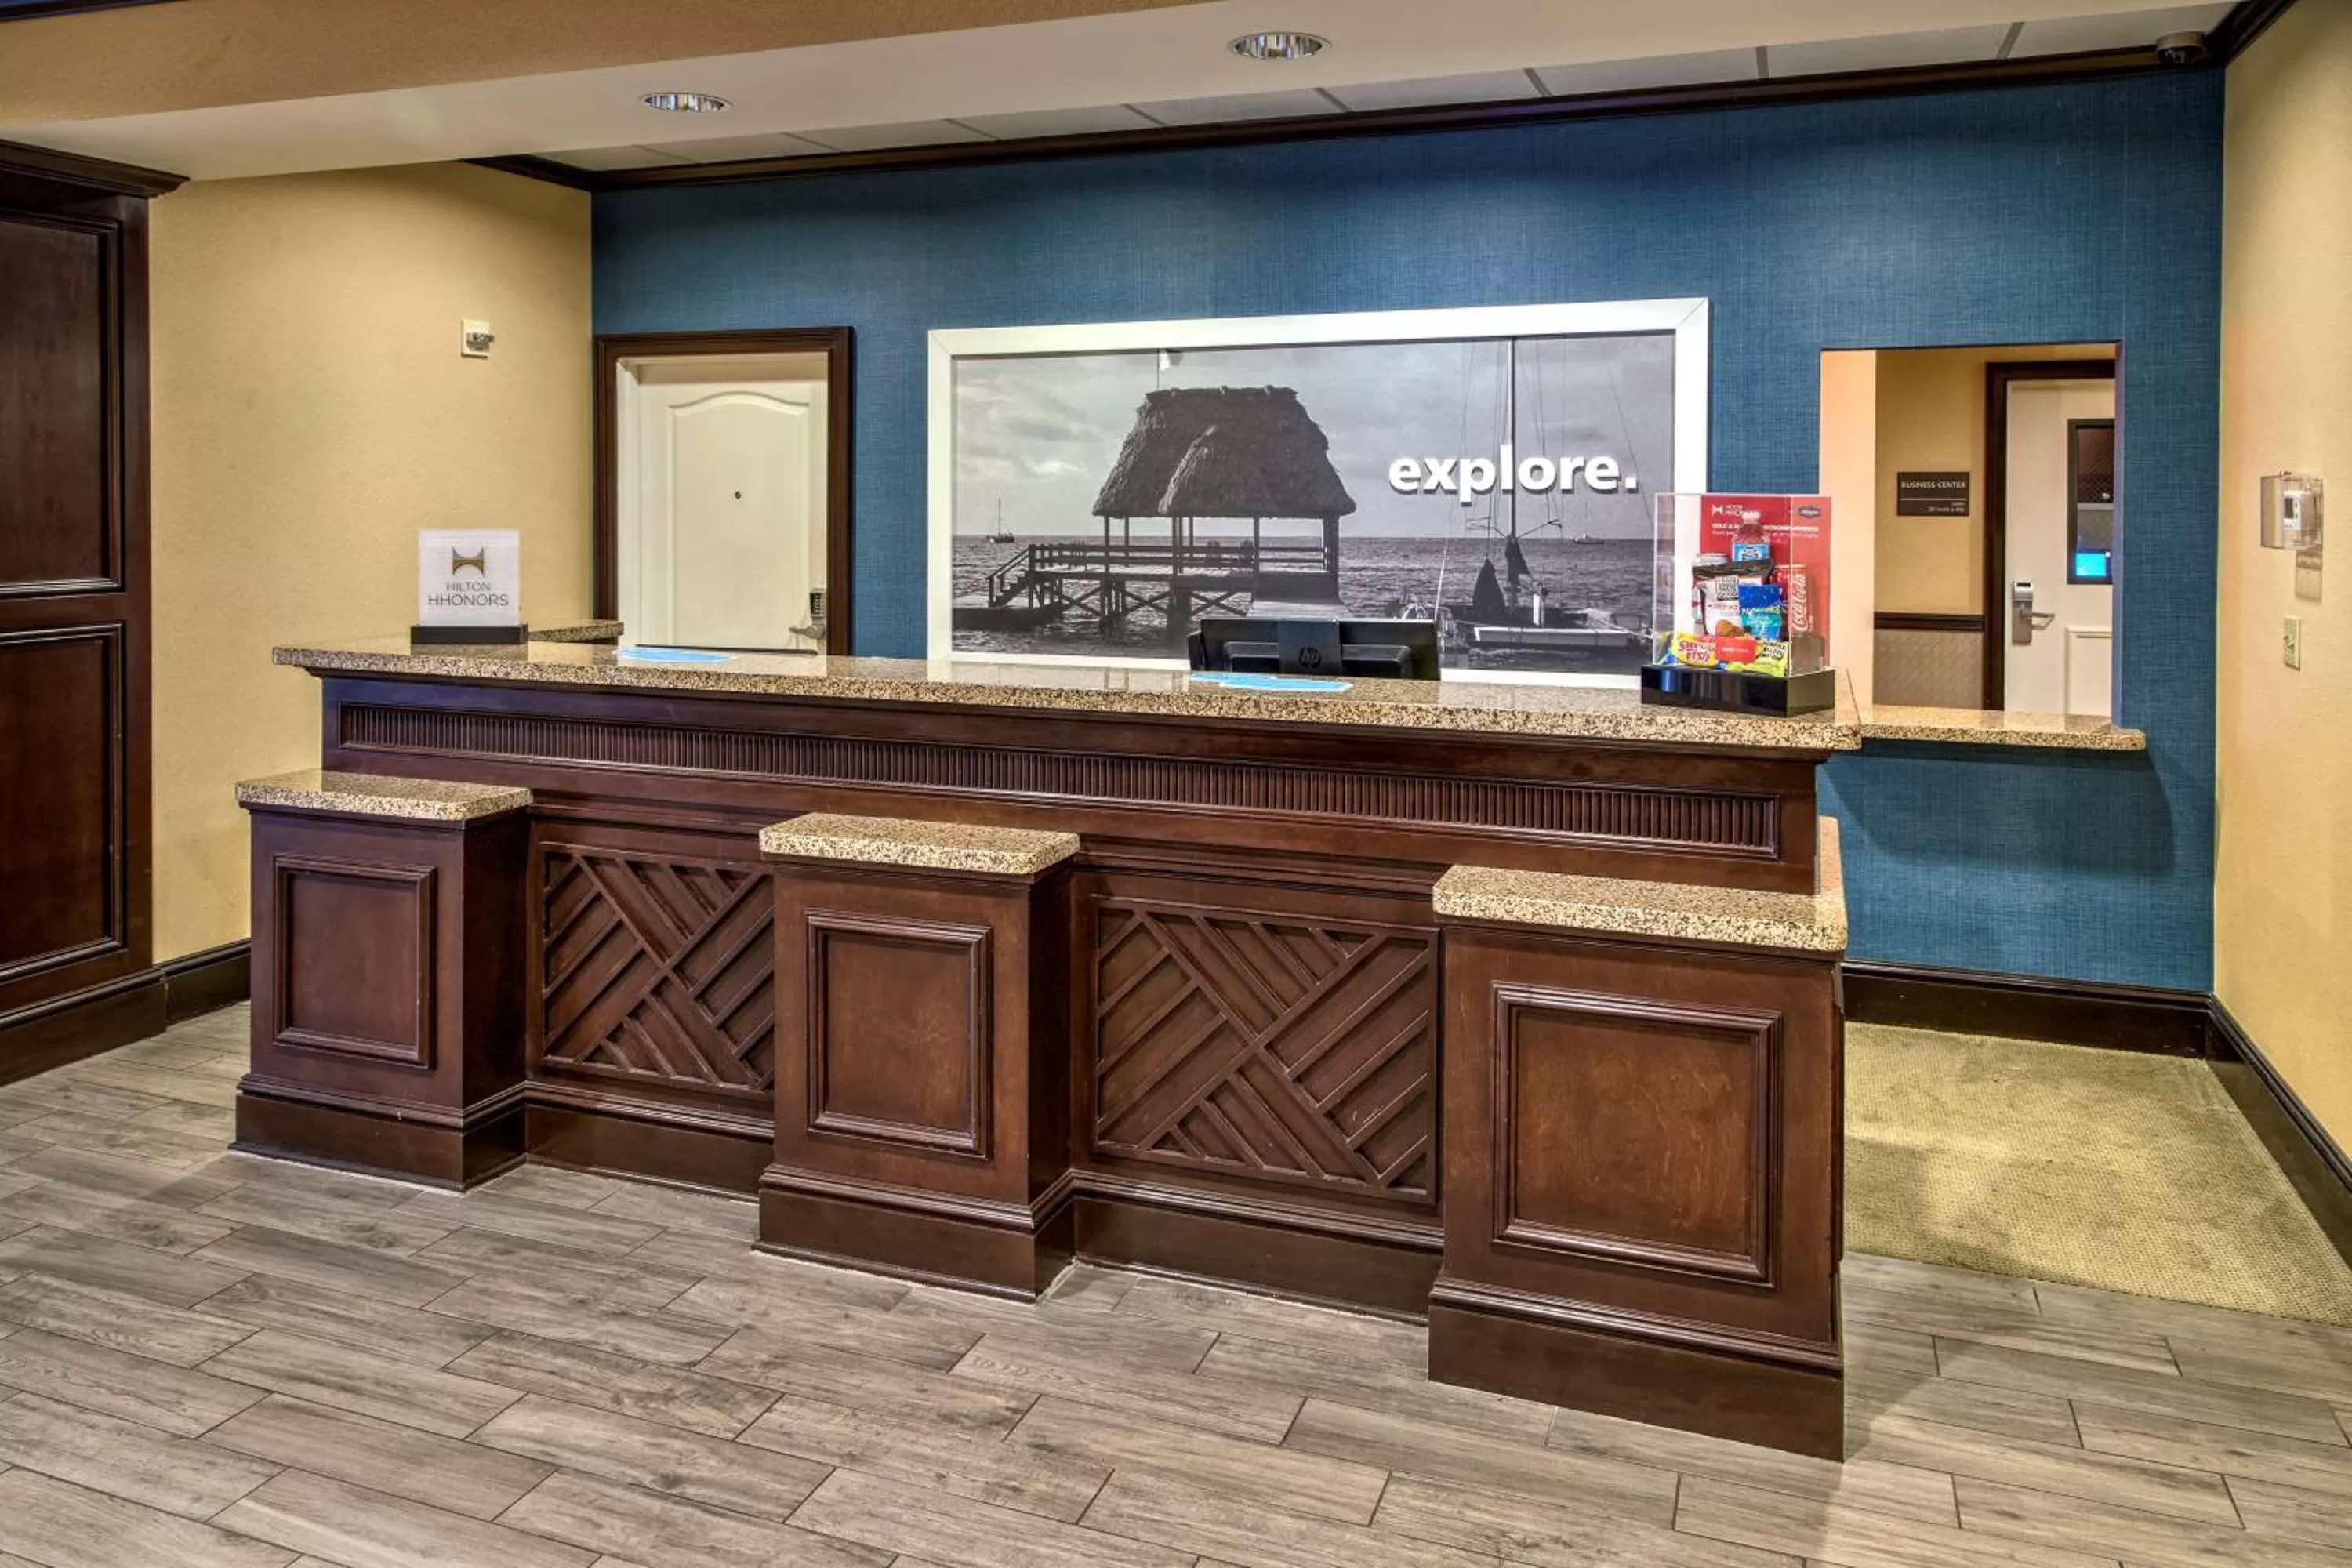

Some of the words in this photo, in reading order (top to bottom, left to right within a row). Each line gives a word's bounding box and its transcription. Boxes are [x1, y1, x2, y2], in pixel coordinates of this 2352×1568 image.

[1388, 445, 1637, 504] explore.
[446, 581, 491, 592] HILTON
[427, 593, 509, 606] HHONORS
